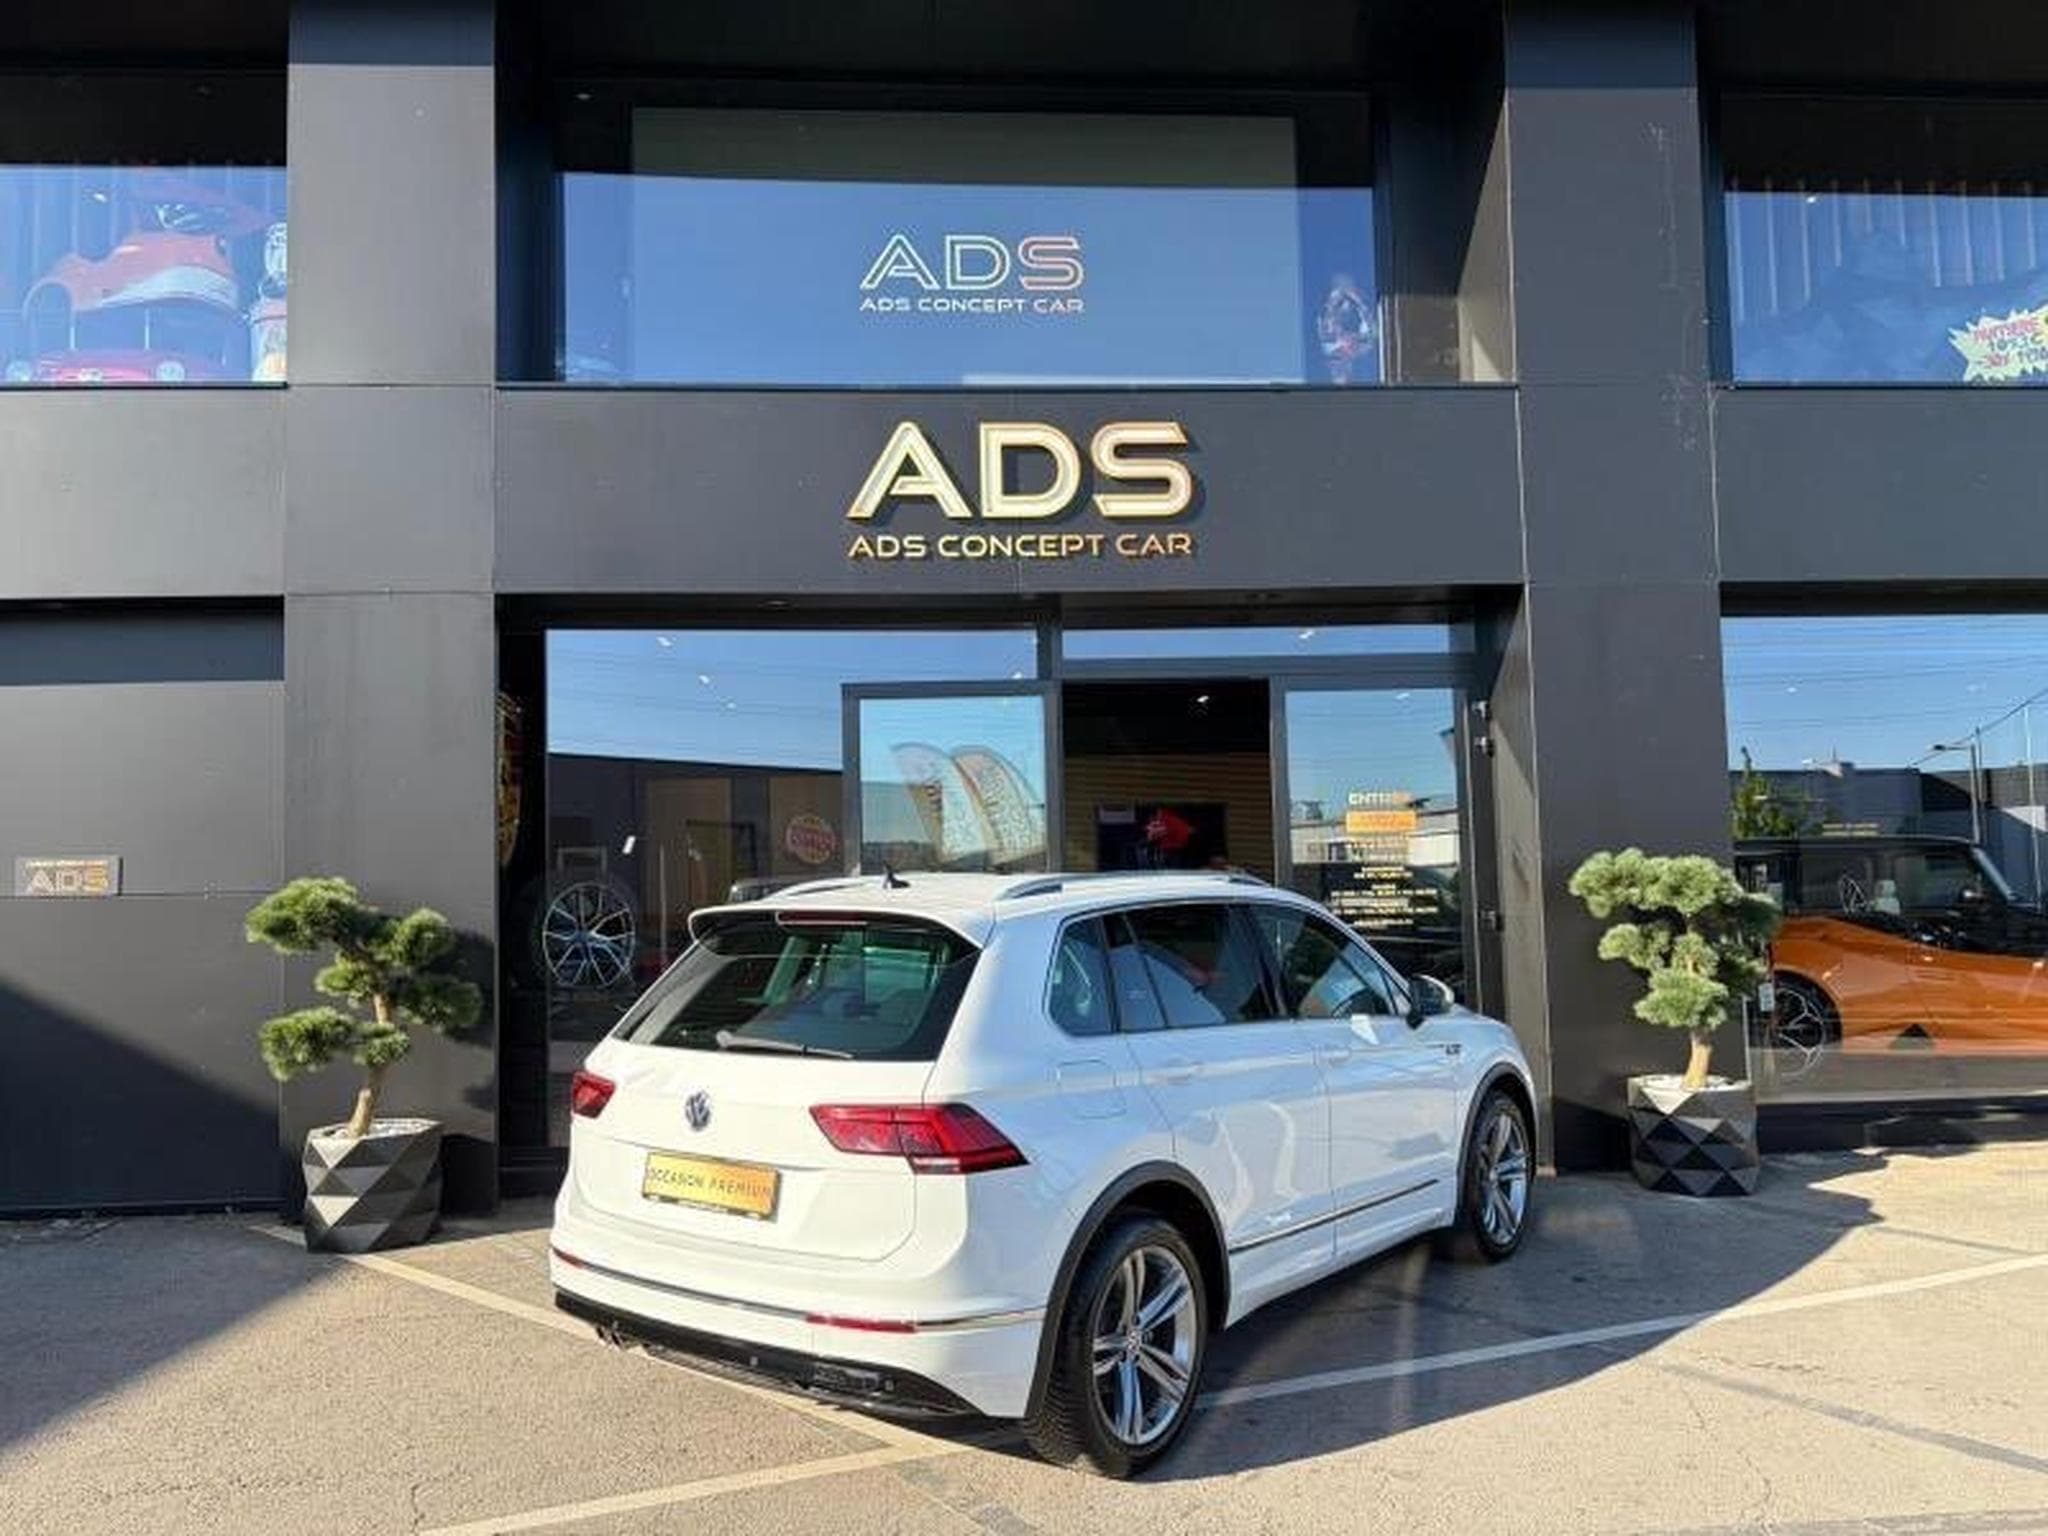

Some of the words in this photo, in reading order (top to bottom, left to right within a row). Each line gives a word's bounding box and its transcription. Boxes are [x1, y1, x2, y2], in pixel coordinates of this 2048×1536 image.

[859, 233, 1084, 290] ADS
[859, 298, 911, 311] ADS
[918, 298, 1024, 313] CONCEPT
[1034, 299, 1084, 314] CAR
[846, 421, 1192, 518] ADS
[849, 535, 926, 557] ADS
[938, 534, 1104, 557] CONCEPT
[1115, 533, 1192, 556] CAR
[24, 869, 108, 895] ADS
